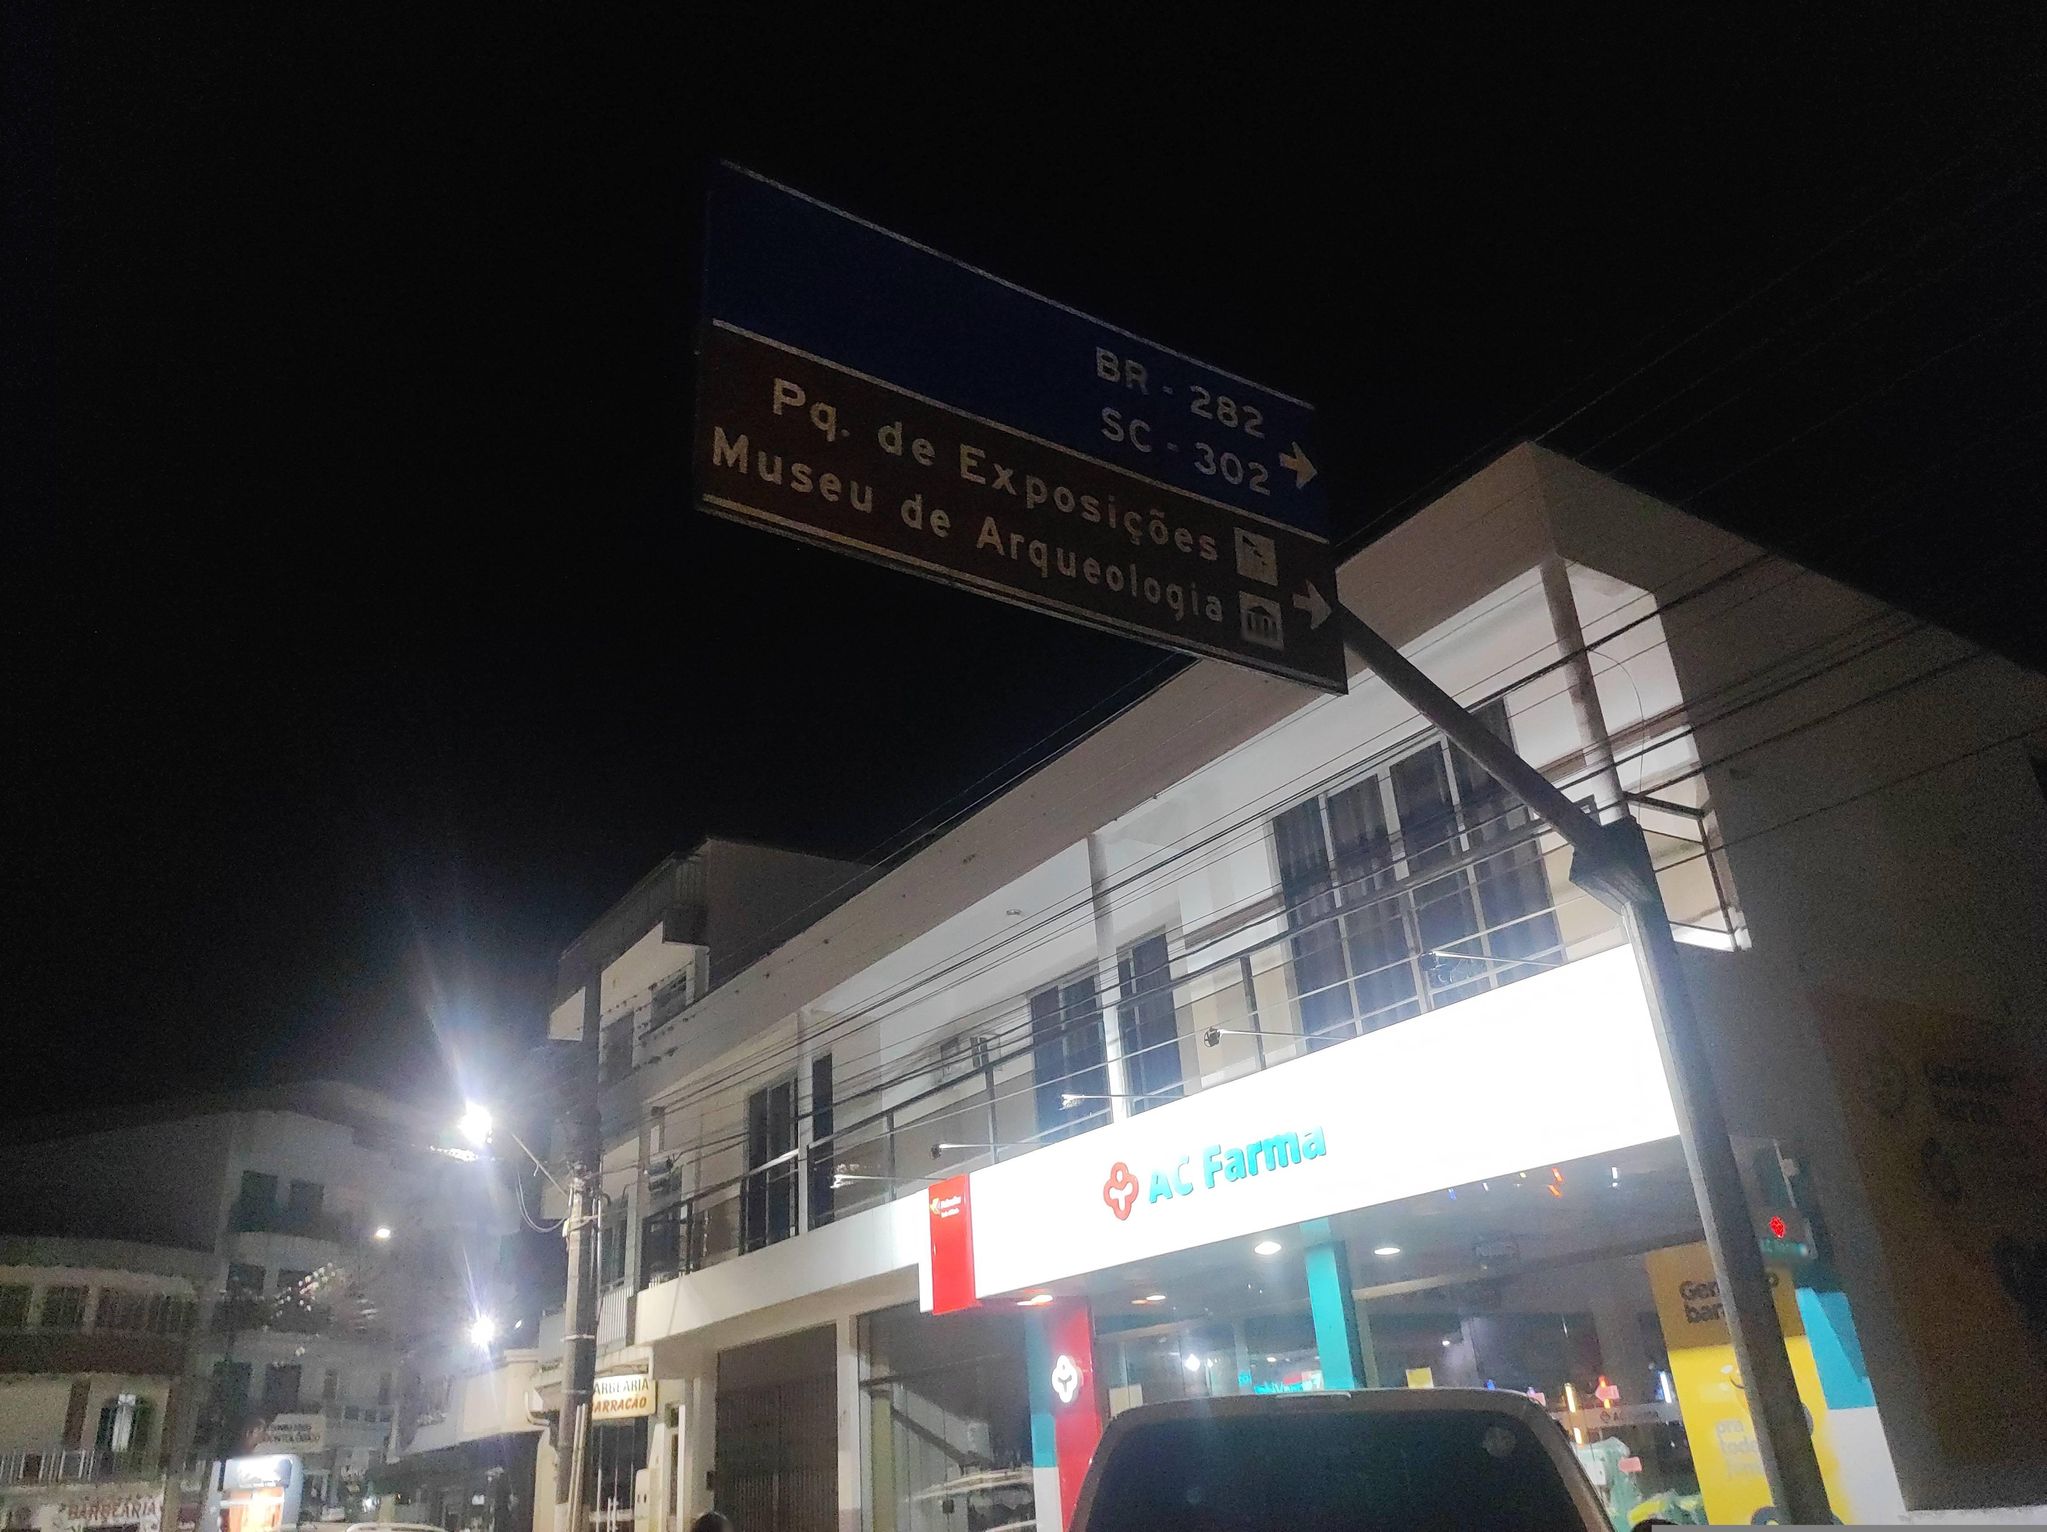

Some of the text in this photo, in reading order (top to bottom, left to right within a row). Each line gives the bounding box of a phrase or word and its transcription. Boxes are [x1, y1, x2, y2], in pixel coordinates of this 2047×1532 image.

[1096, 346, 1150, 396] BR
[1190, 385, 1266, 440] 282
[772, 377, 1218, 561] Pq. de Exposições
[1101, 406, 1152, 453] SC
[1194, 442, 1271, 496] 302
[712, 425, 1223, 622] Museu de Arqueologia
[1149, 1125, 1327, 1204] AC Farma
[593, 1378, 649, 1395] ARBEARIA
